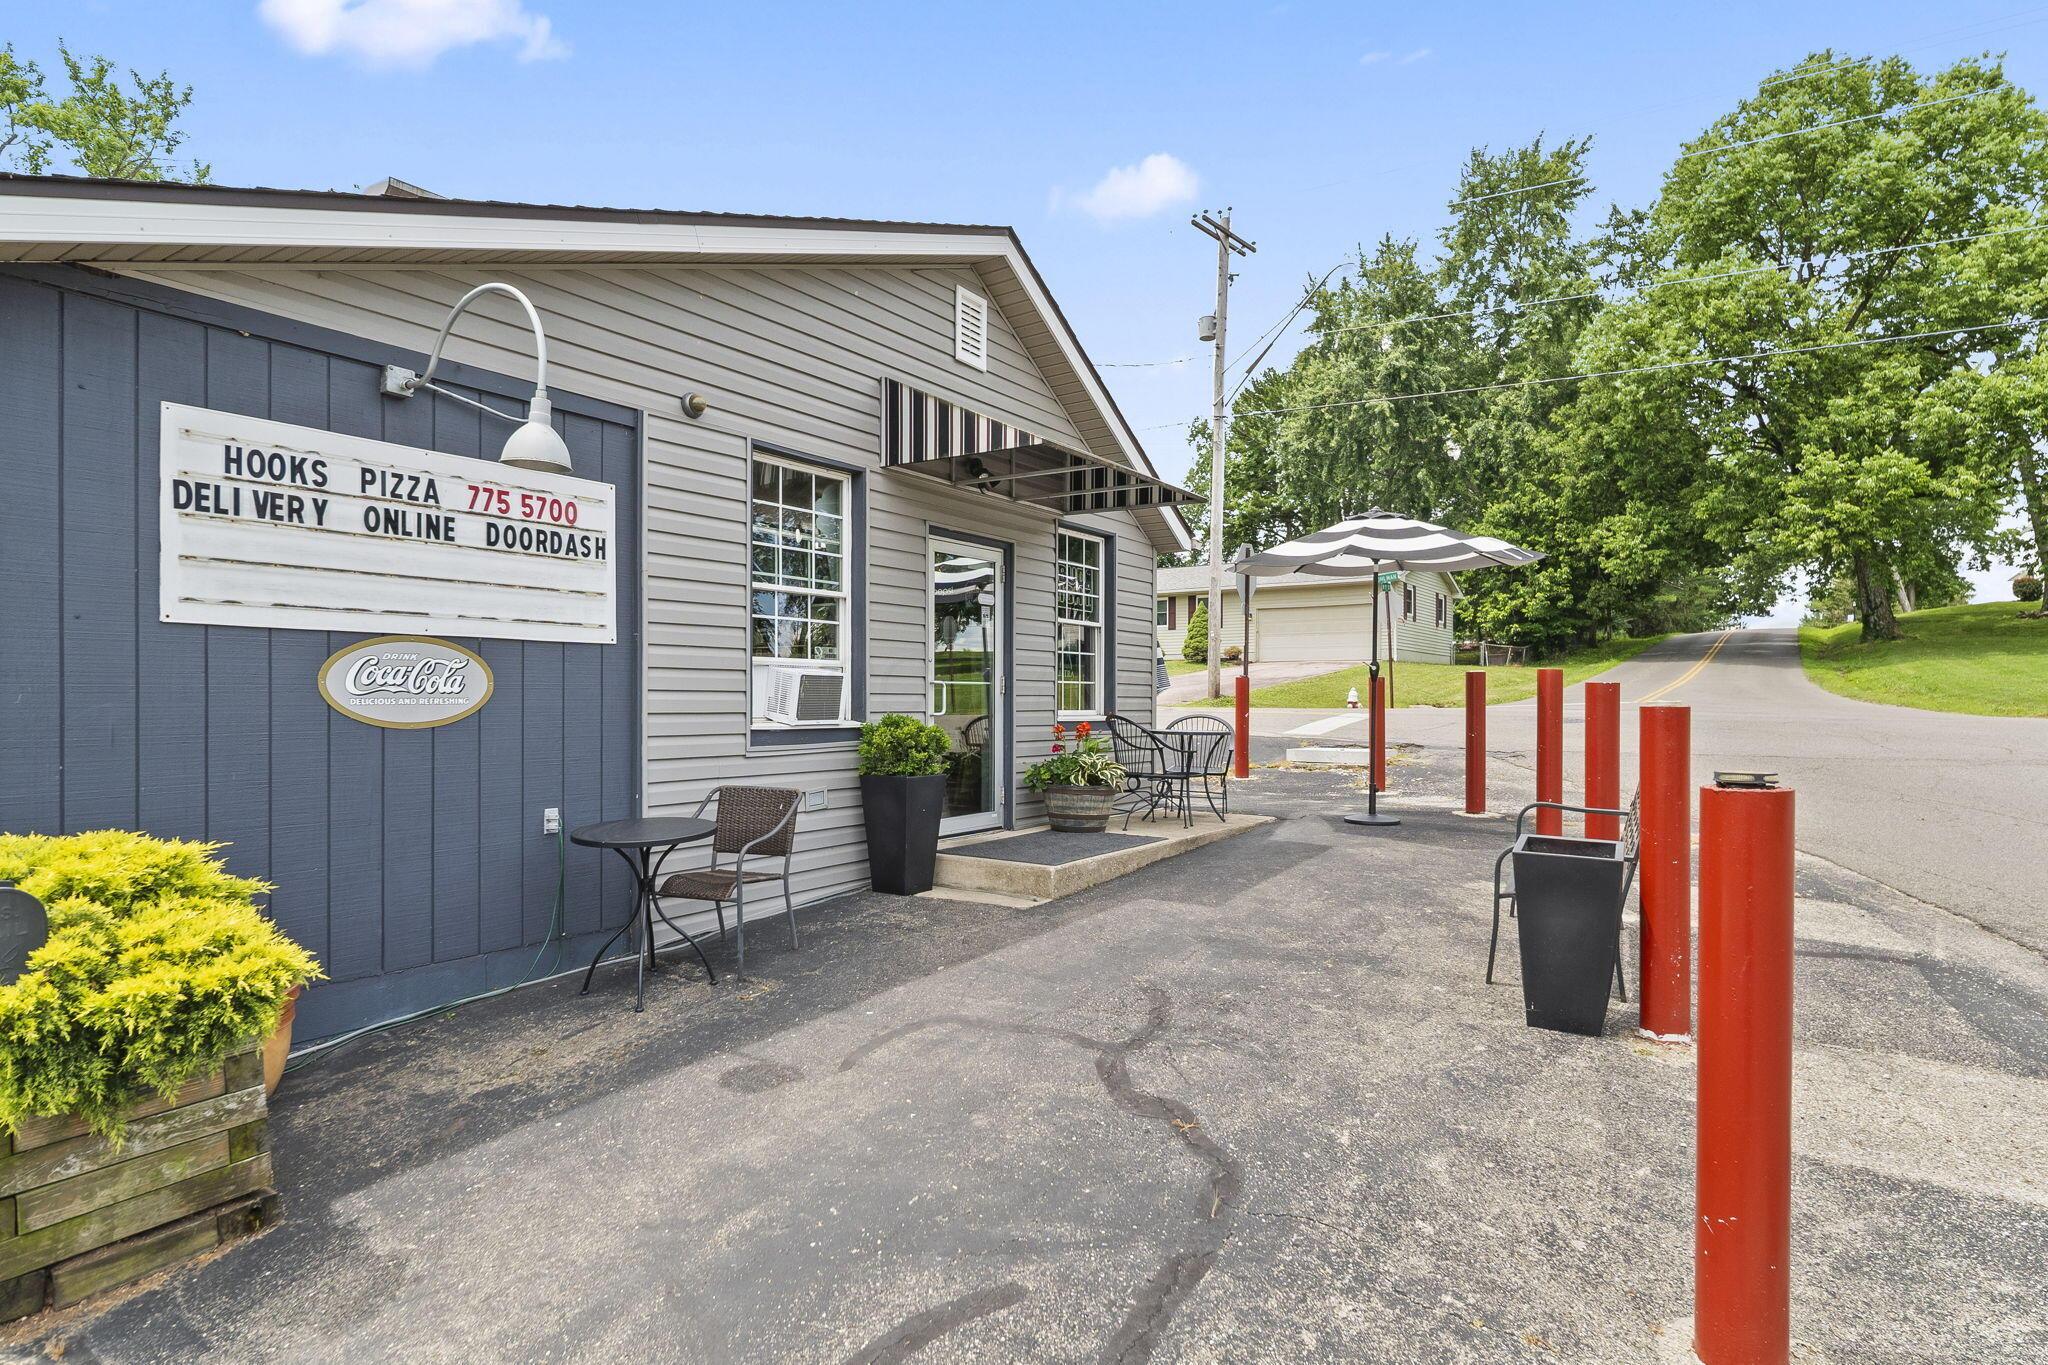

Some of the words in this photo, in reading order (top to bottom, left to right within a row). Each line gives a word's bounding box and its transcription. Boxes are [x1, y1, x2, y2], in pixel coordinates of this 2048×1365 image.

[224, 444, 328, 488] HOOKS
[360, 467, 440, 505] PIZZA
[468, 484, 511, 515] 775
[521, 493, 578, 525] 5700
[363, 505, 456, 542] ONLINE
[486, 521, 606, 560] DOORDASH
[345, 655, 470, 696] Coca-Cola
[381, 652, 420, 661] DRINK
[350, 697, 396, 706] DELICIOUS
[399, 697, 417, 705] AND
[419, 697, 470, 705] REFRESHING
